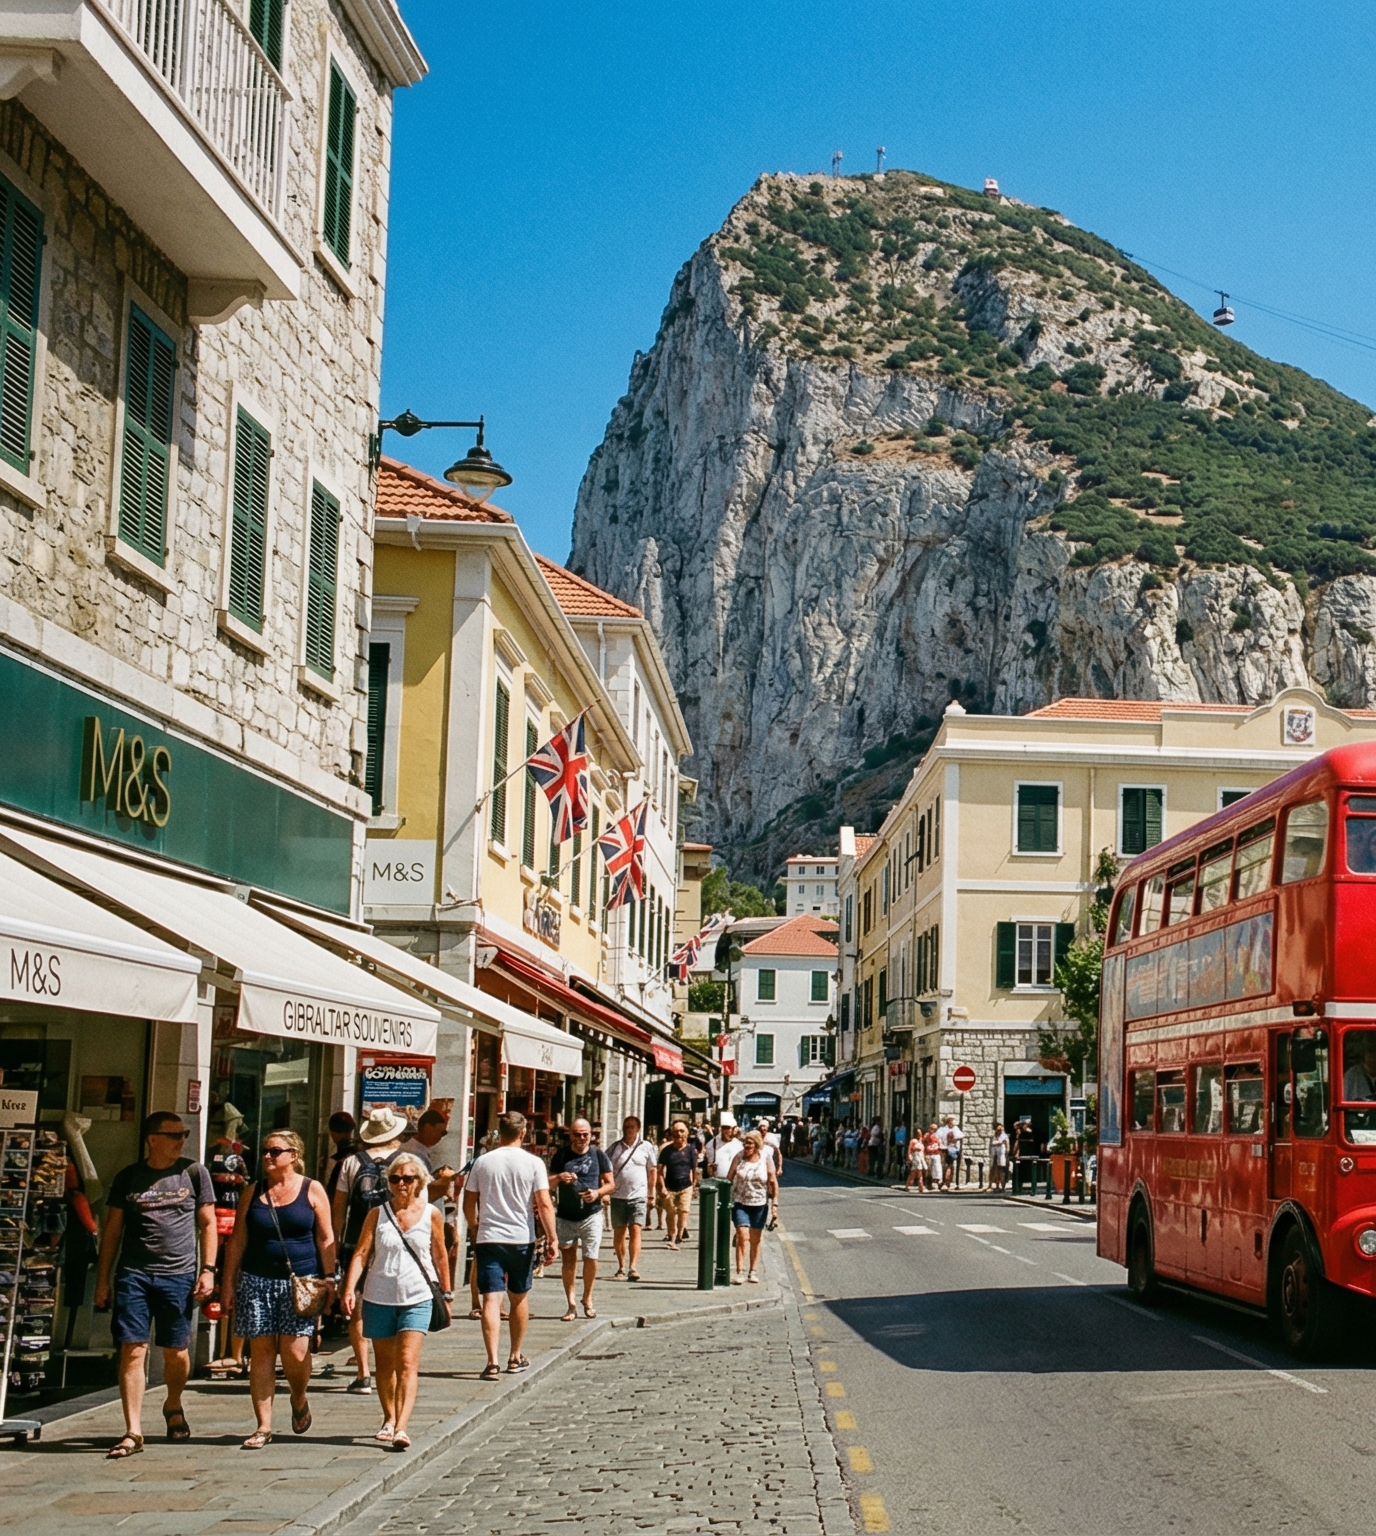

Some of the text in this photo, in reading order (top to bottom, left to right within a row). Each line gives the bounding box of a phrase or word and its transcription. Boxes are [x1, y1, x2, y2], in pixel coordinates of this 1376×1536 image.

[87, 716, 172, 828] M&S
[372, 862, 425, 882] M&S
[11, 948, 61, 996] M&S
[283, 1000, 412, 1048] GIBRALTAR SOUVENIRS
